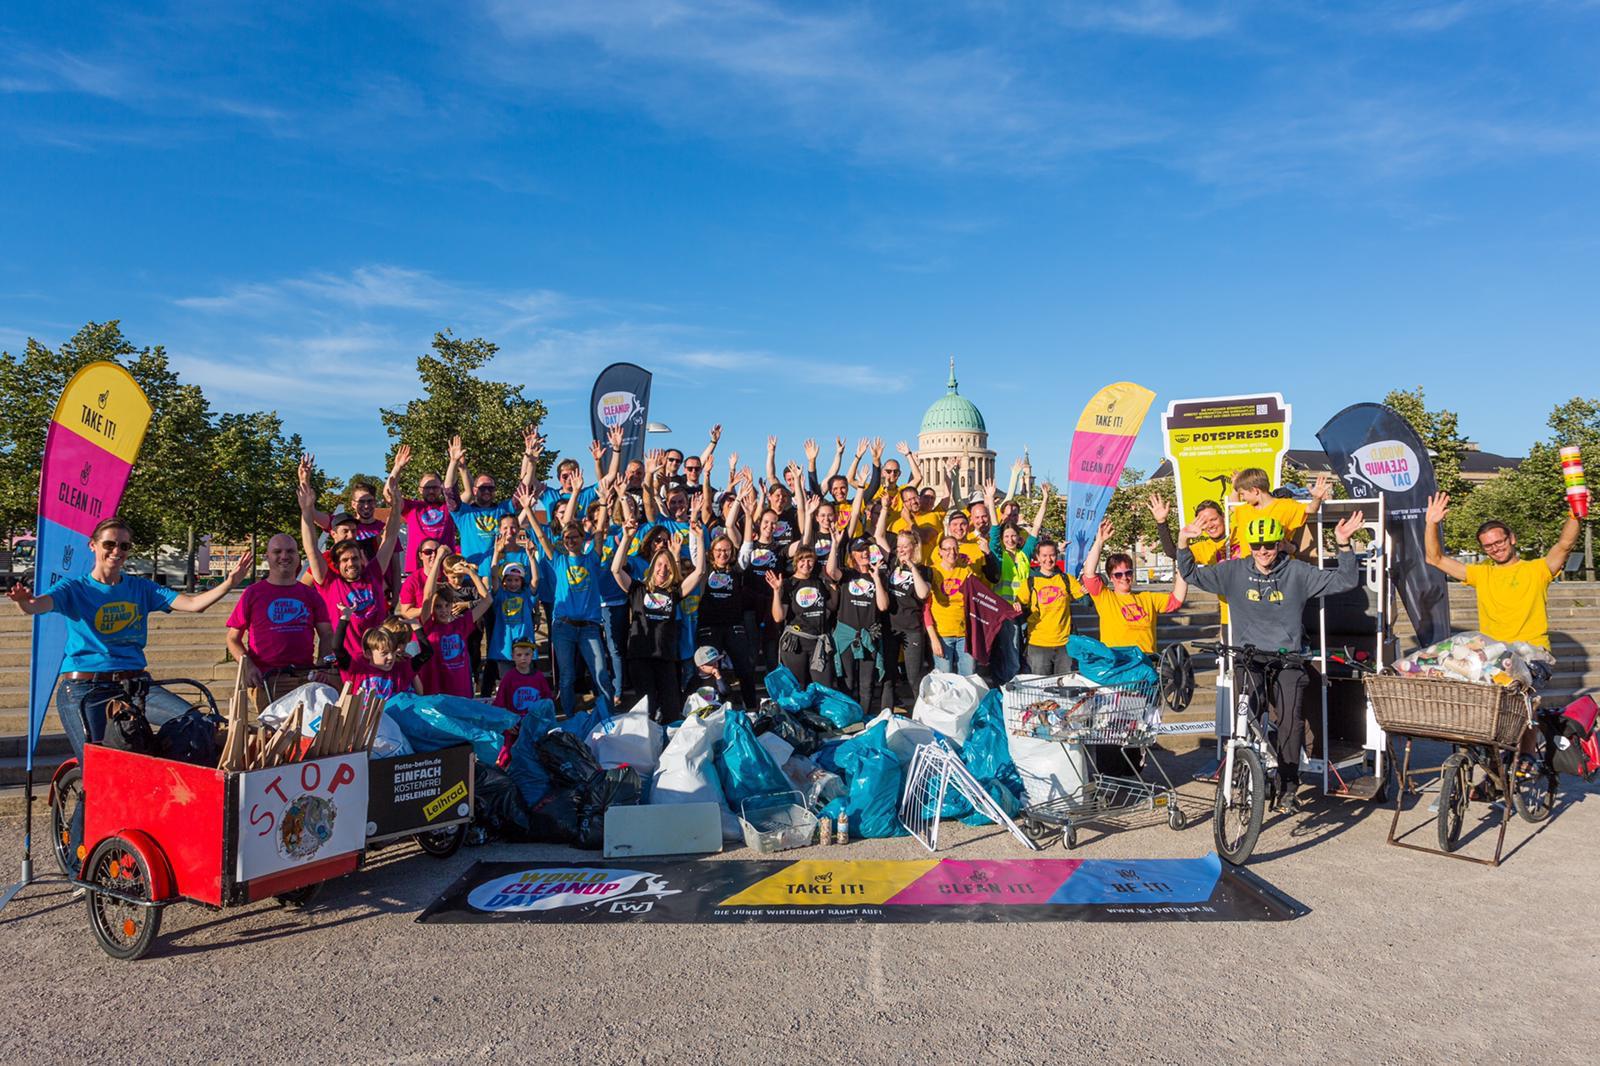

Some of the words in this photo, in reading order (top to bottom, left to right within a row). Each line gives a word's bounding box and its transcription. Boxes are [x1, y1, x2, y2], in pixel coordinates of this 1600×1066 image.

[603, 403, 630, 416] CLEANUP
[81, 404, 103, 433] TAKE
[103, 418, 117, 440] IT!
[604, 415, 618, 426] DAY
[1095, 415, 1112, 427] TAKE
[1113, 416, 1123, 428] IT!
[1193, 428, 1279, 443] POTSPRESSO
[1081, 460, 1103, 474] CLEAN
[58, 482, 88, 512] CLEAN
[89, 496, 102, 518] IT!
[1075, 507, 1085, 519] BE
[1086, 509, 1096, 521] IT!
[103, 604, 126, 613] WORLD
[102, 612, 132, 623] CLEANUP
[100, 622, 115, 632] DAY
[394, 758, 442, 771] flotte-berlin.de
[394, 766, 442, 784] EINFACH
[394, 778, 442, 793] KOSTENFREI
[249, 762, 356, 837] STOP
[426, 785, 464, 816] Leihrad
[518, 872, 609, 883] WORLD
[501, 883, 620, 895] CLEANUP
[785, 884, 833, 895] TAKE
[840, 883, 865, 895] IT!
[938, 883, 1001, 895] CLEAN
[1007, 883, 1034, 894] IT!
[1111, 882, 1140, 894] BE
[1142, 882, 1174, 893] IT!
[483, 895, 545, 907] DAY
[828, 908, 858, 916] RÄUMT
